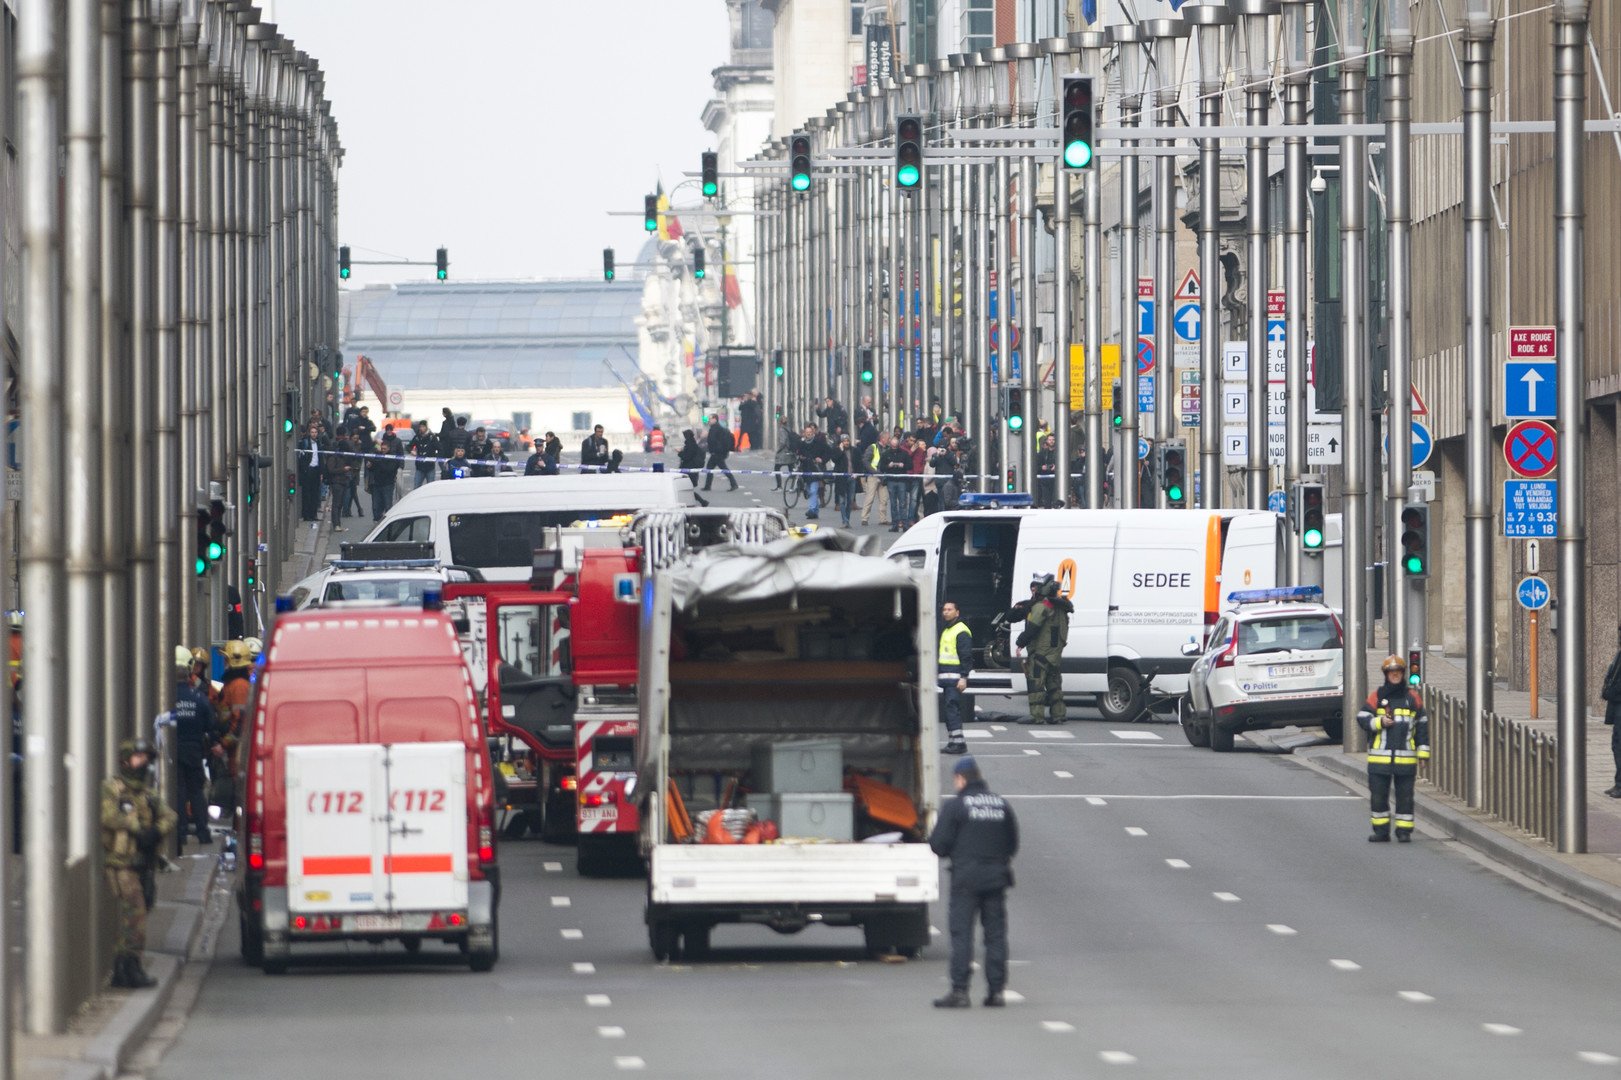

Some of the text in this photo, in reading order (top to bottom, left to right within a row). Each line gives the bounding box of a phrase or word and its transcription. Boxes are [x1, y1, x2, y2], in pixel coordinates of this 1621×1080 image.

[869, 40, 880, 86] orkspace
[1513, 333, 1552, 342] AXE ROUGE
[1517, 345, 1548, 353] RODE AS
[1232, 355, 1241, 367] P
[1232, 397, 1241, 409] P
[1232, 440, 1241, 451] P
[1517, 512, 1525, 522] 7
[1515, 524, 1527, 534] 13
[1542, 524, 1554, 534] 18
[1133, 572, 1191, 588] SEDEE
[1253, 682, 1278, 690] Politie
[176, 700, 197, 708] olitie
[176, 708, 196, 717] olice
[322, 791, 364, 813] 112
[404, 789, 447, 811] 112
[963, 793, 1005, 806] Politie
[968, 806, 1005, 819] Police
